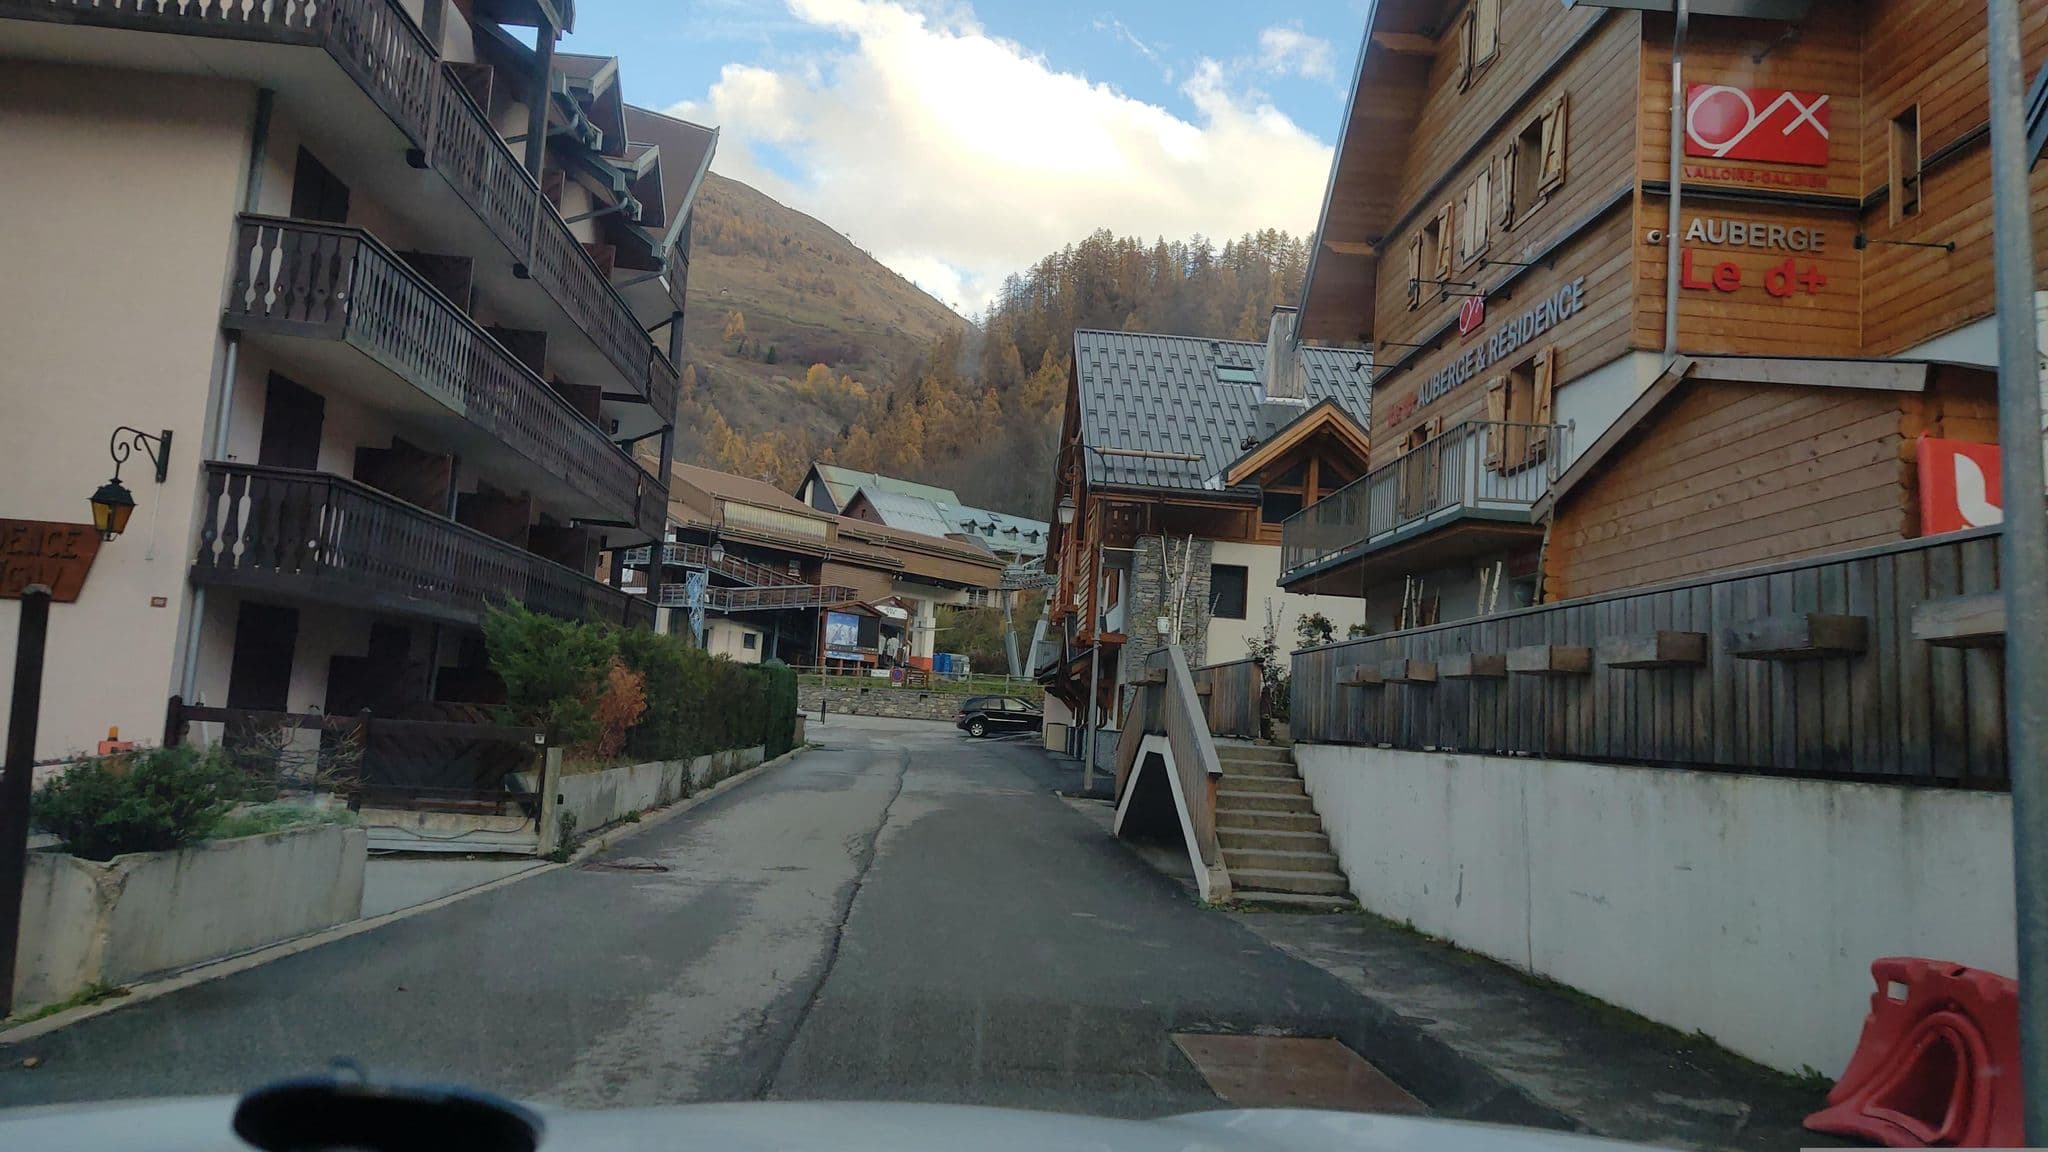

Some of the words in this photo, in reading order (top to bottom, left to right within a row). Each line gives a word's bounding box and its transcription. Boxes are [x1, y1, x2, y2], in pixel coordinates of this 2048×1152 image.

[1685, 217, 1825, 252] AUBERGE
[1681, 247, 1742, 292] Le
[1417, 349, 1473, 409] AUBERGE
[1476, 343, 1487, 371] &
